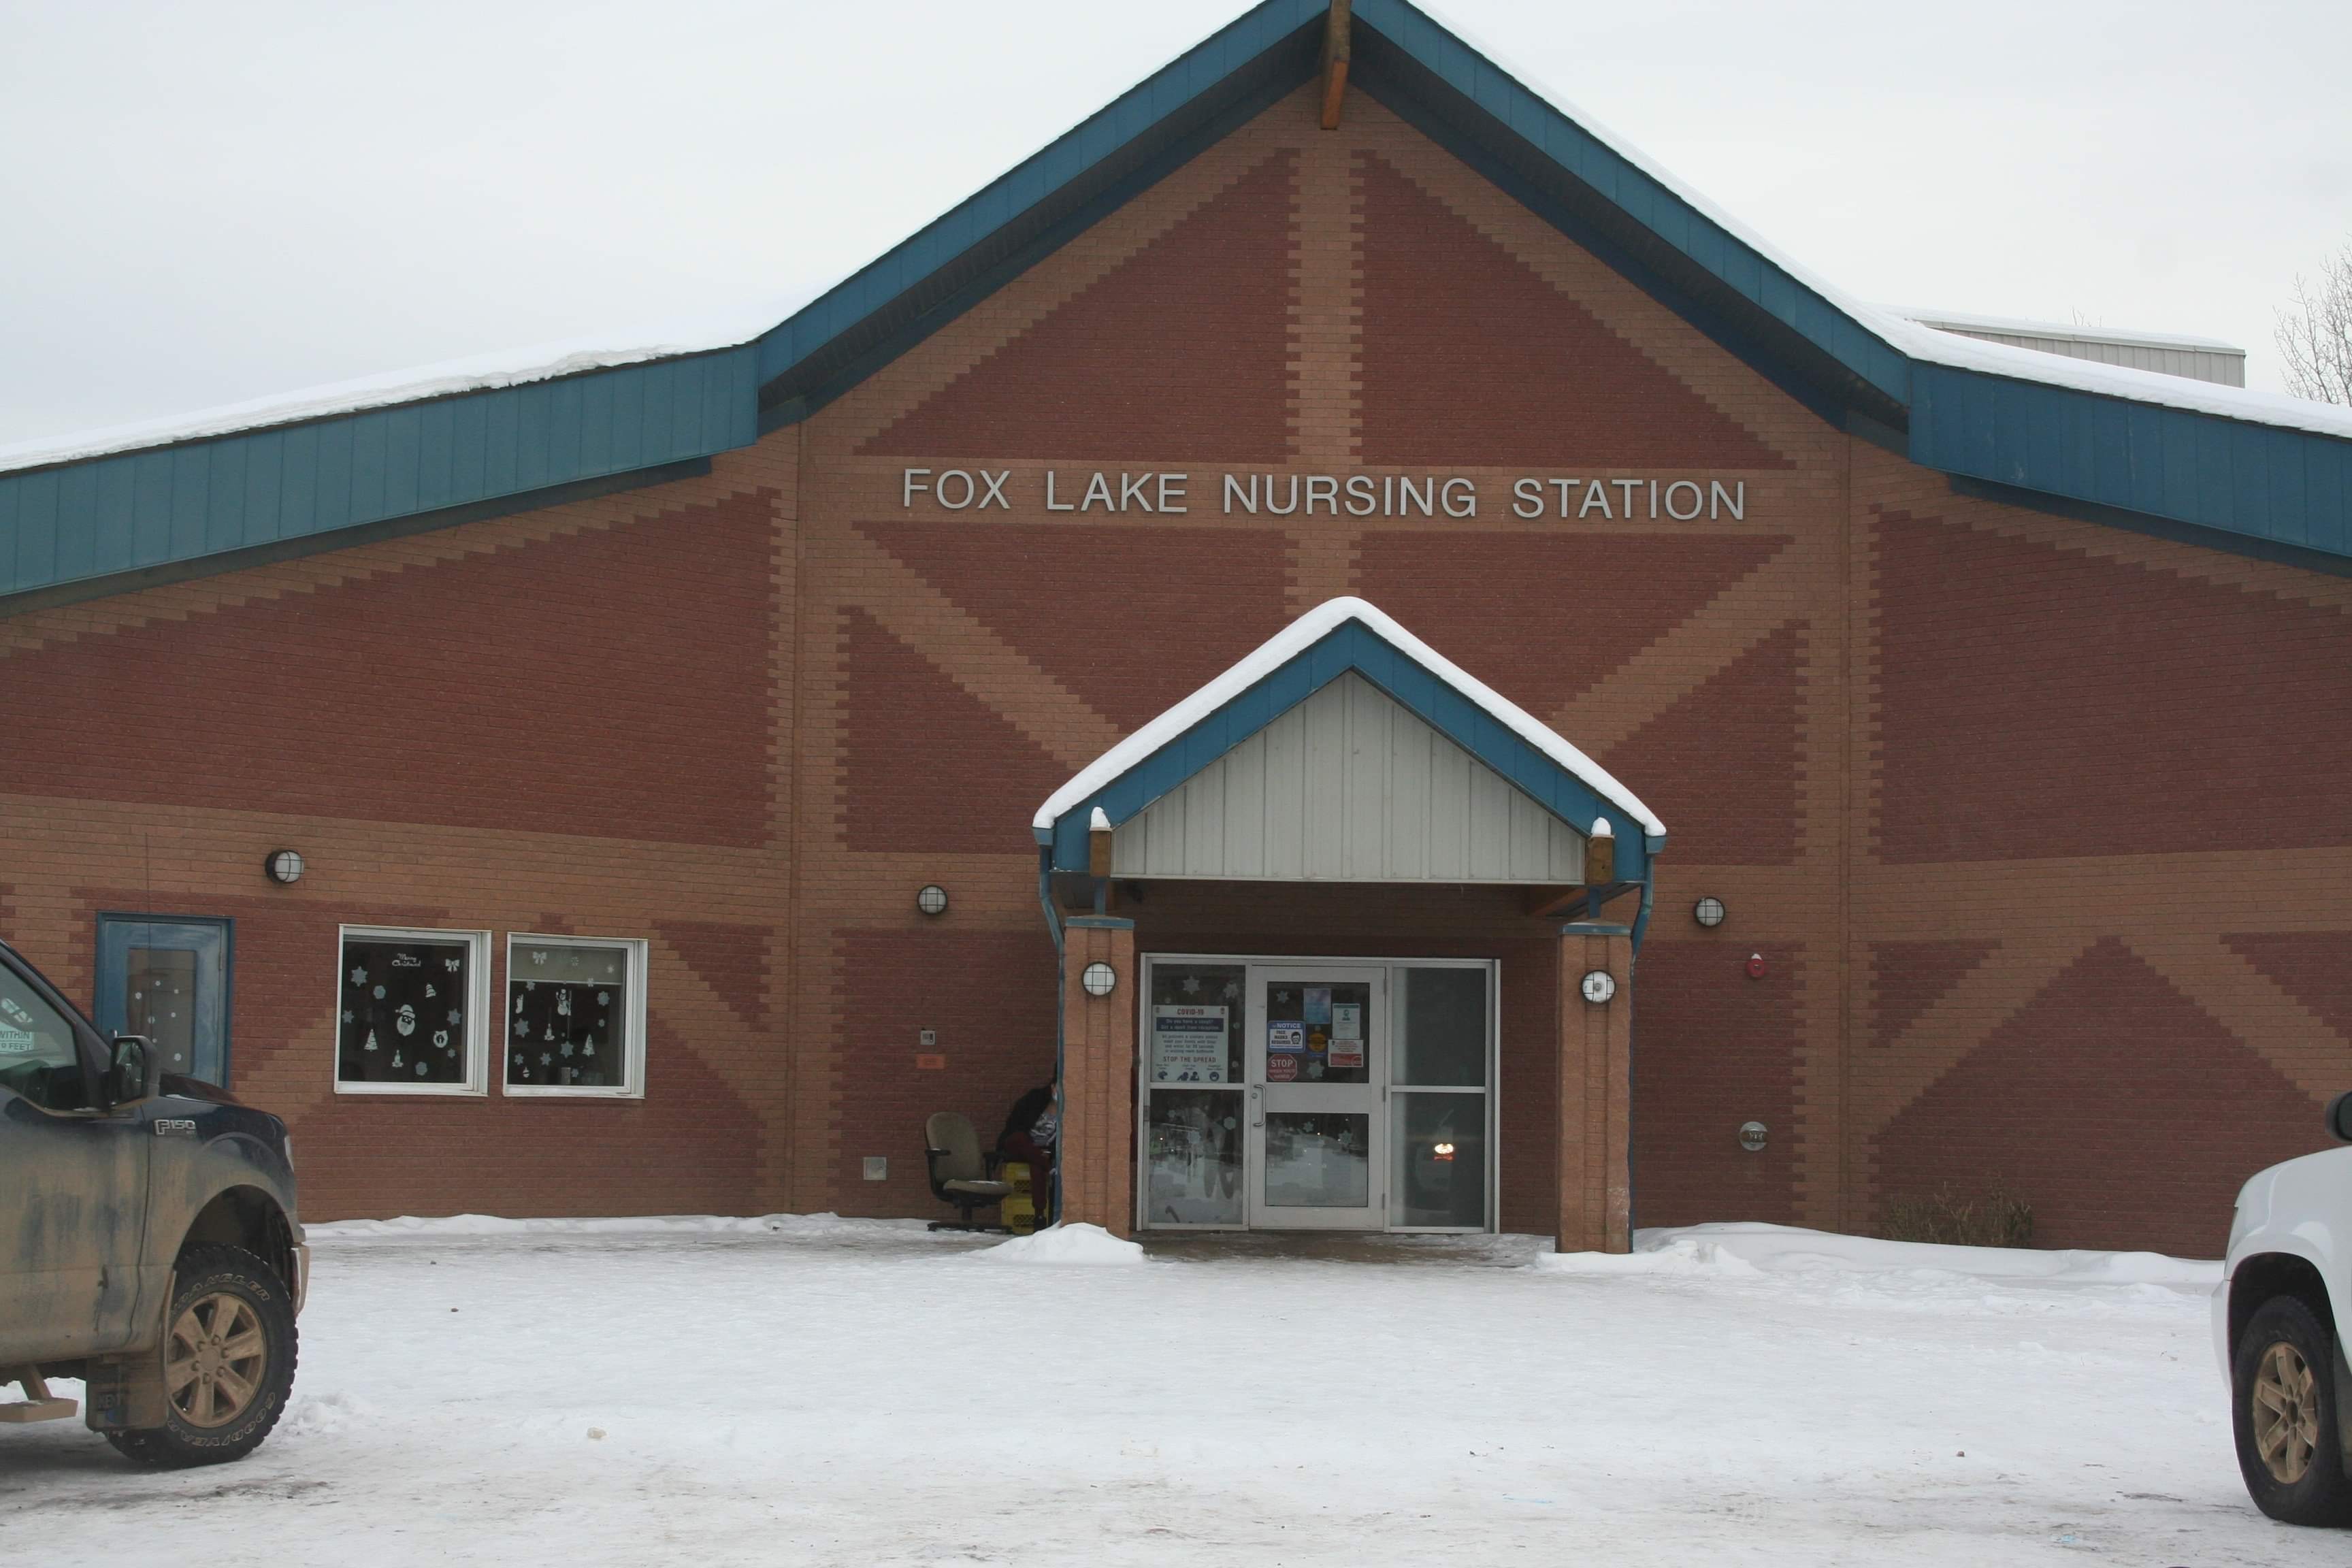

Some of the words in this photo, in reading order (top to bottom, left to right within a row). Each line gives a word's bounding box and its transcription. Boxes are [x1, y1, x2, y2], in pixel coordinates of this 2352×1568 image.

[903, 468, 1011, 510] FOX
[1047, 470, 1188, 513] LAKE
[1224, 474, 1476, 517] NURSING
[1513, 478, 1744, 521] STATION
[1271, 1059, 1293, 1067] STOP
[167, 1392, 276, 1447] GOODYEAR
